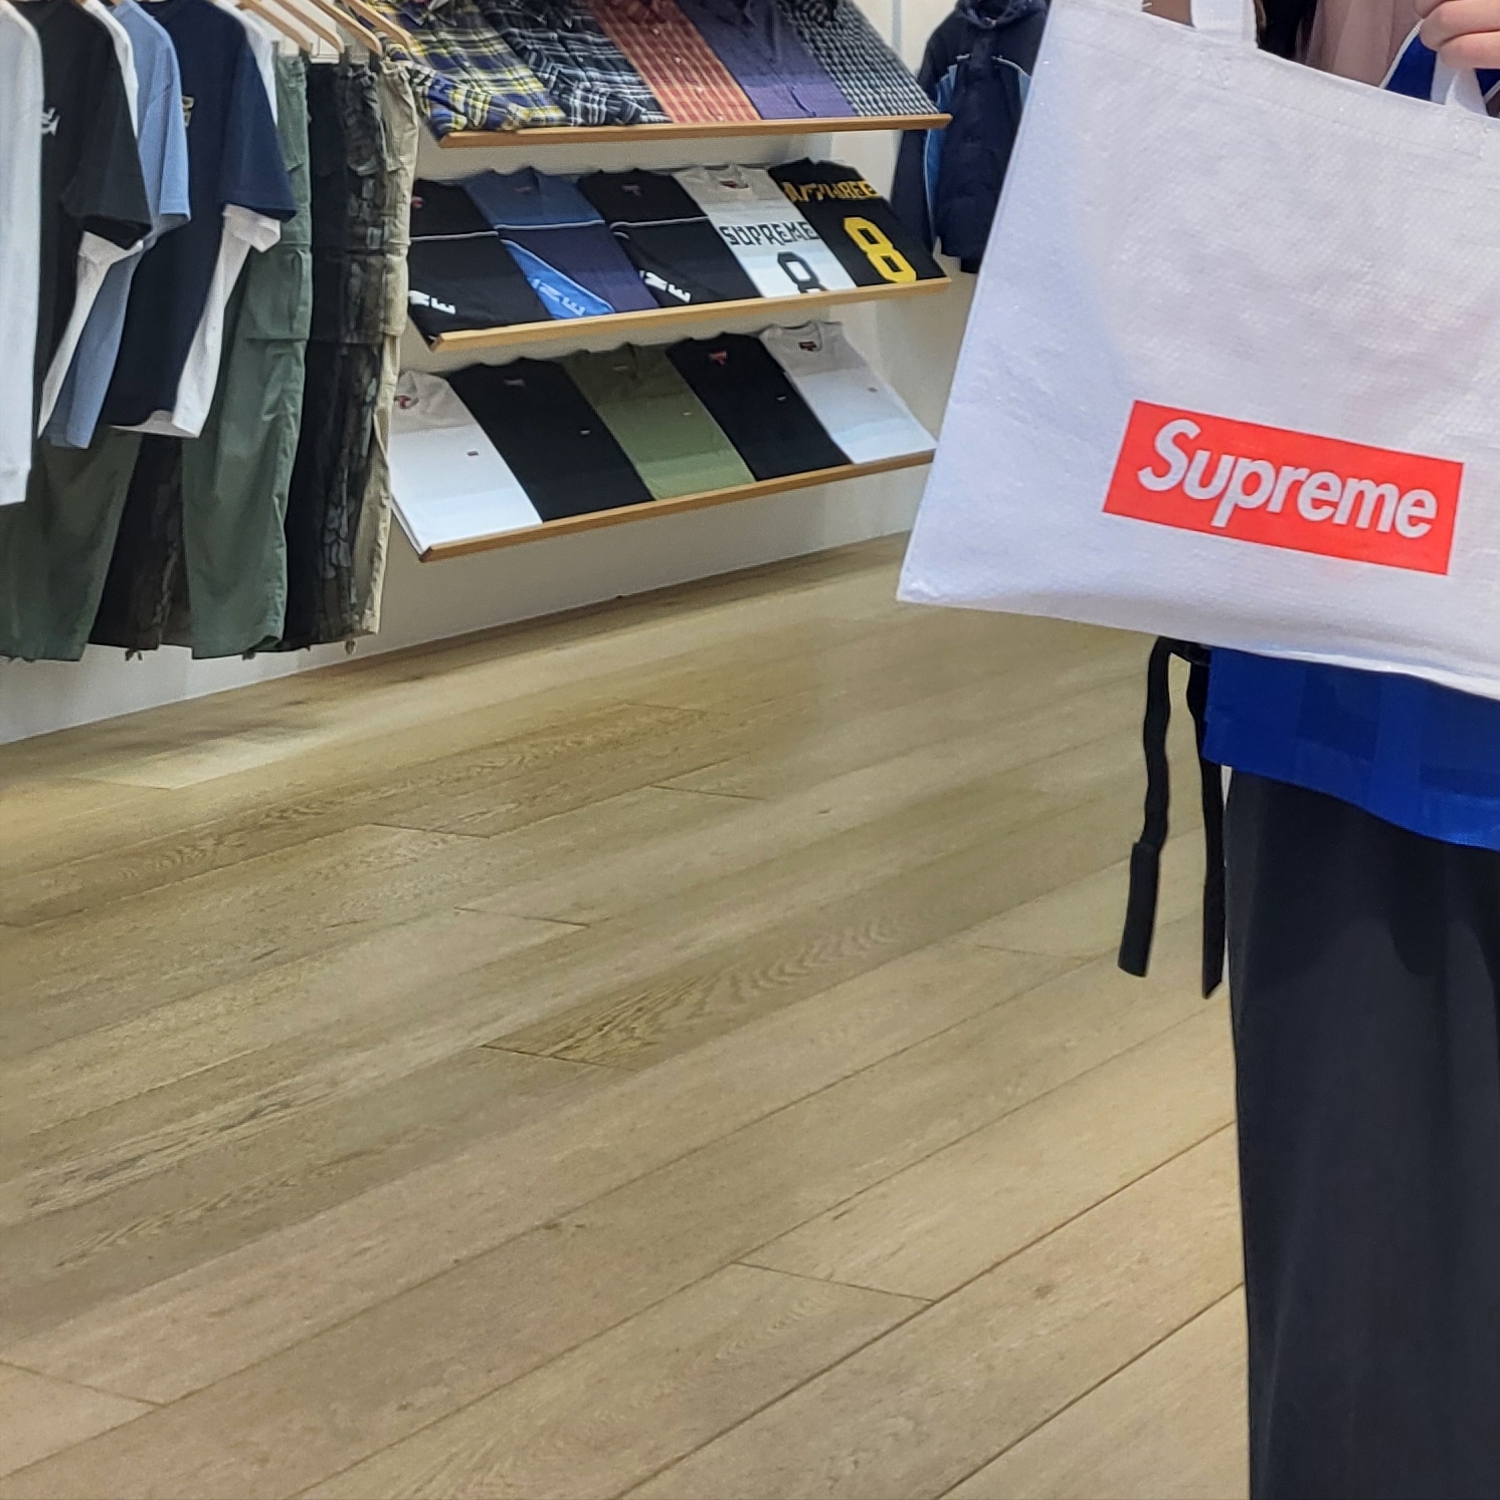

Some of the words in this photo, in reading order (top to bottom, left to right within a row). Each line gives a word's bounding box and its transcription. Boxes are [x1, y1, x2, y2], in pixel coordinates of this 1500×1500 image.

[719, 221, 822, 246] SUPREME
[843, 216, 917, 283] 8
[1137, 418, 1439, 539] Supreme
